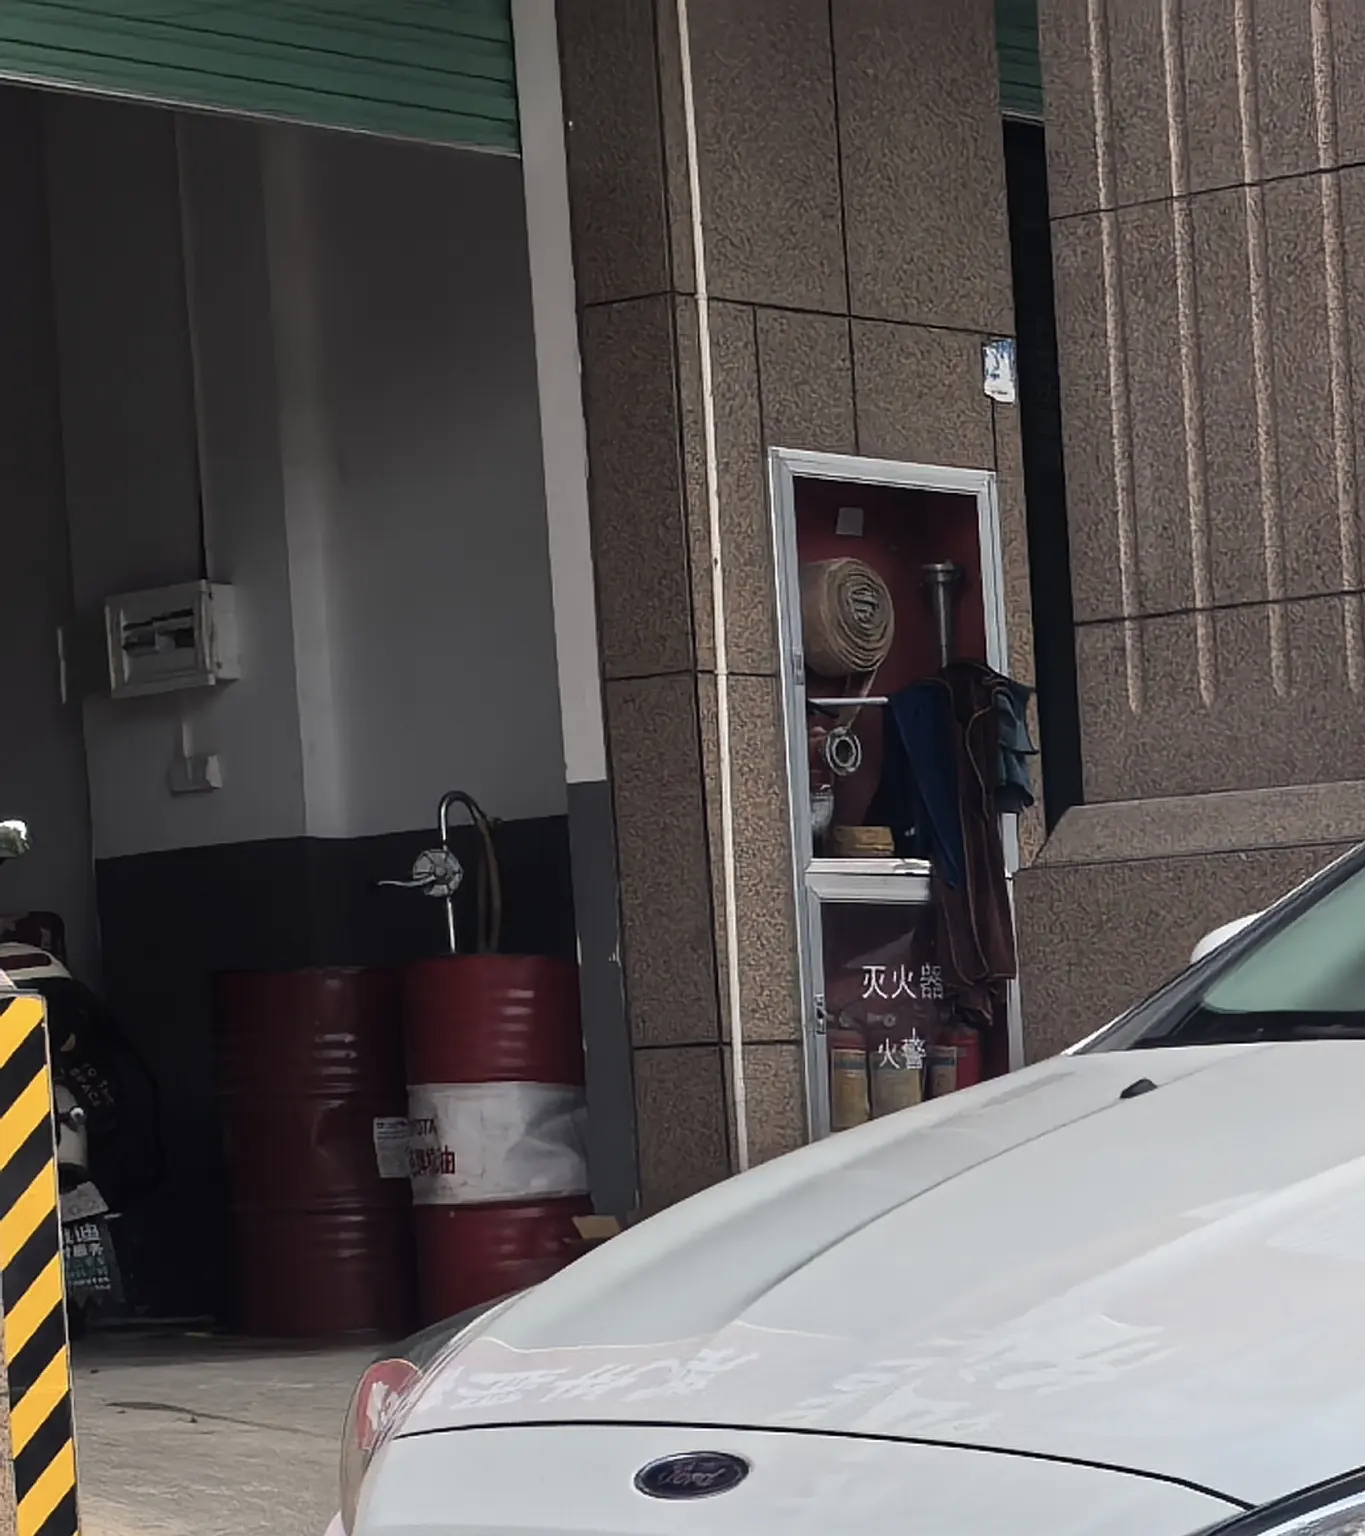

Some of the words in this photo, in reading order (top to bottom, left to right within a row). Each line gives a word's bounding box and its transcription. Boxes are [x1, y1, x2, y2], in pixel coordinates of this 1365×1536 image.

[861, 961, 945, 1000] 灭火器
[877, 1026, 928, 1070] 火警
